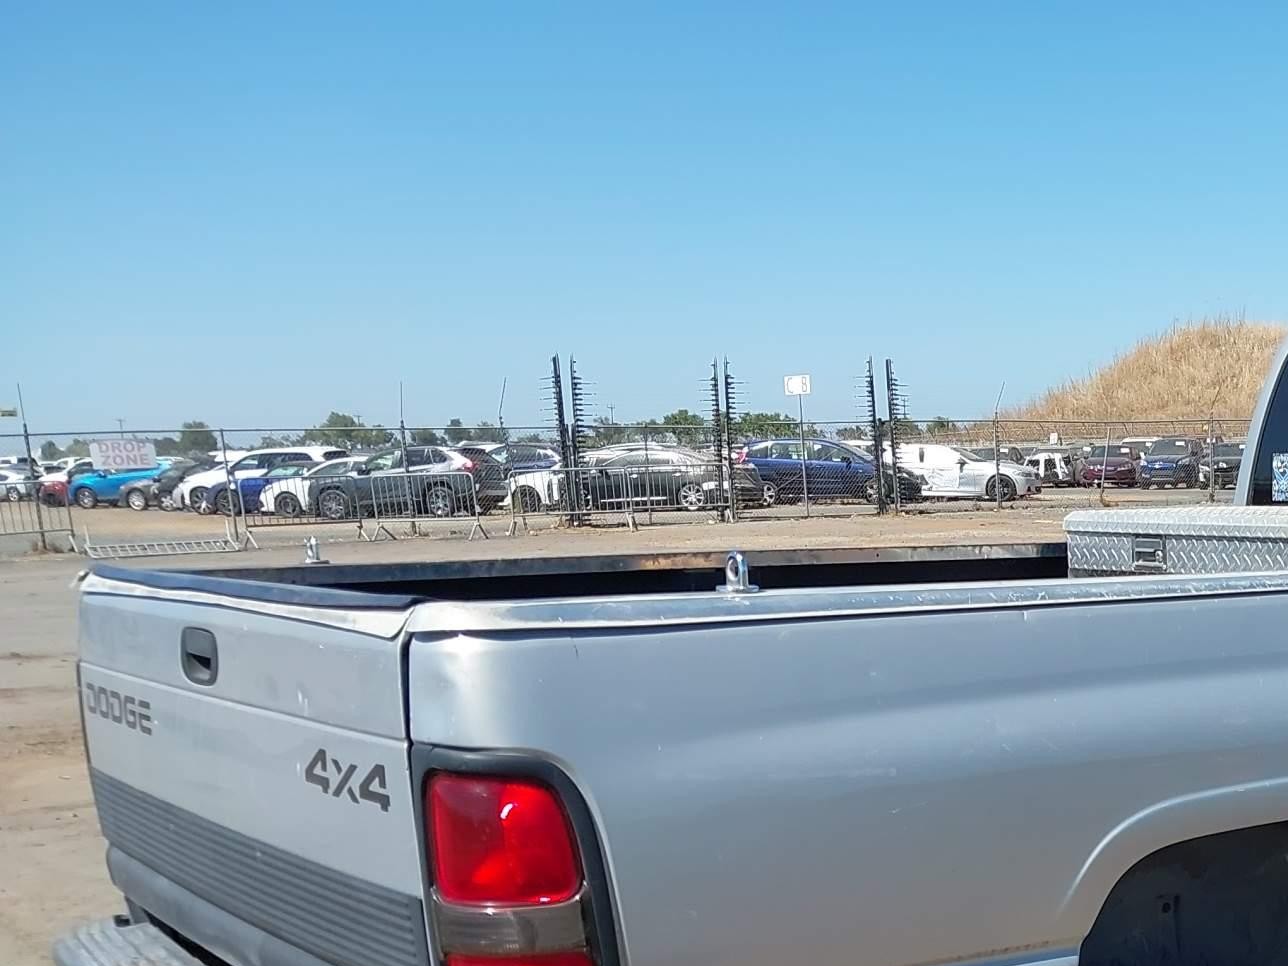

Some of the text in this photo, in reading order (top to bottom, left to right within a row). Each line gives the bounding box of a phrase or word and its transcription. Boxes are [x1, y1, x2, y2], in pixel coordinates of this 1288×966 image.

[97, 440, 147, 454] DROP
[100, 453, 151, 466] ZONE
[85, 681, 153, 737] DODGE
